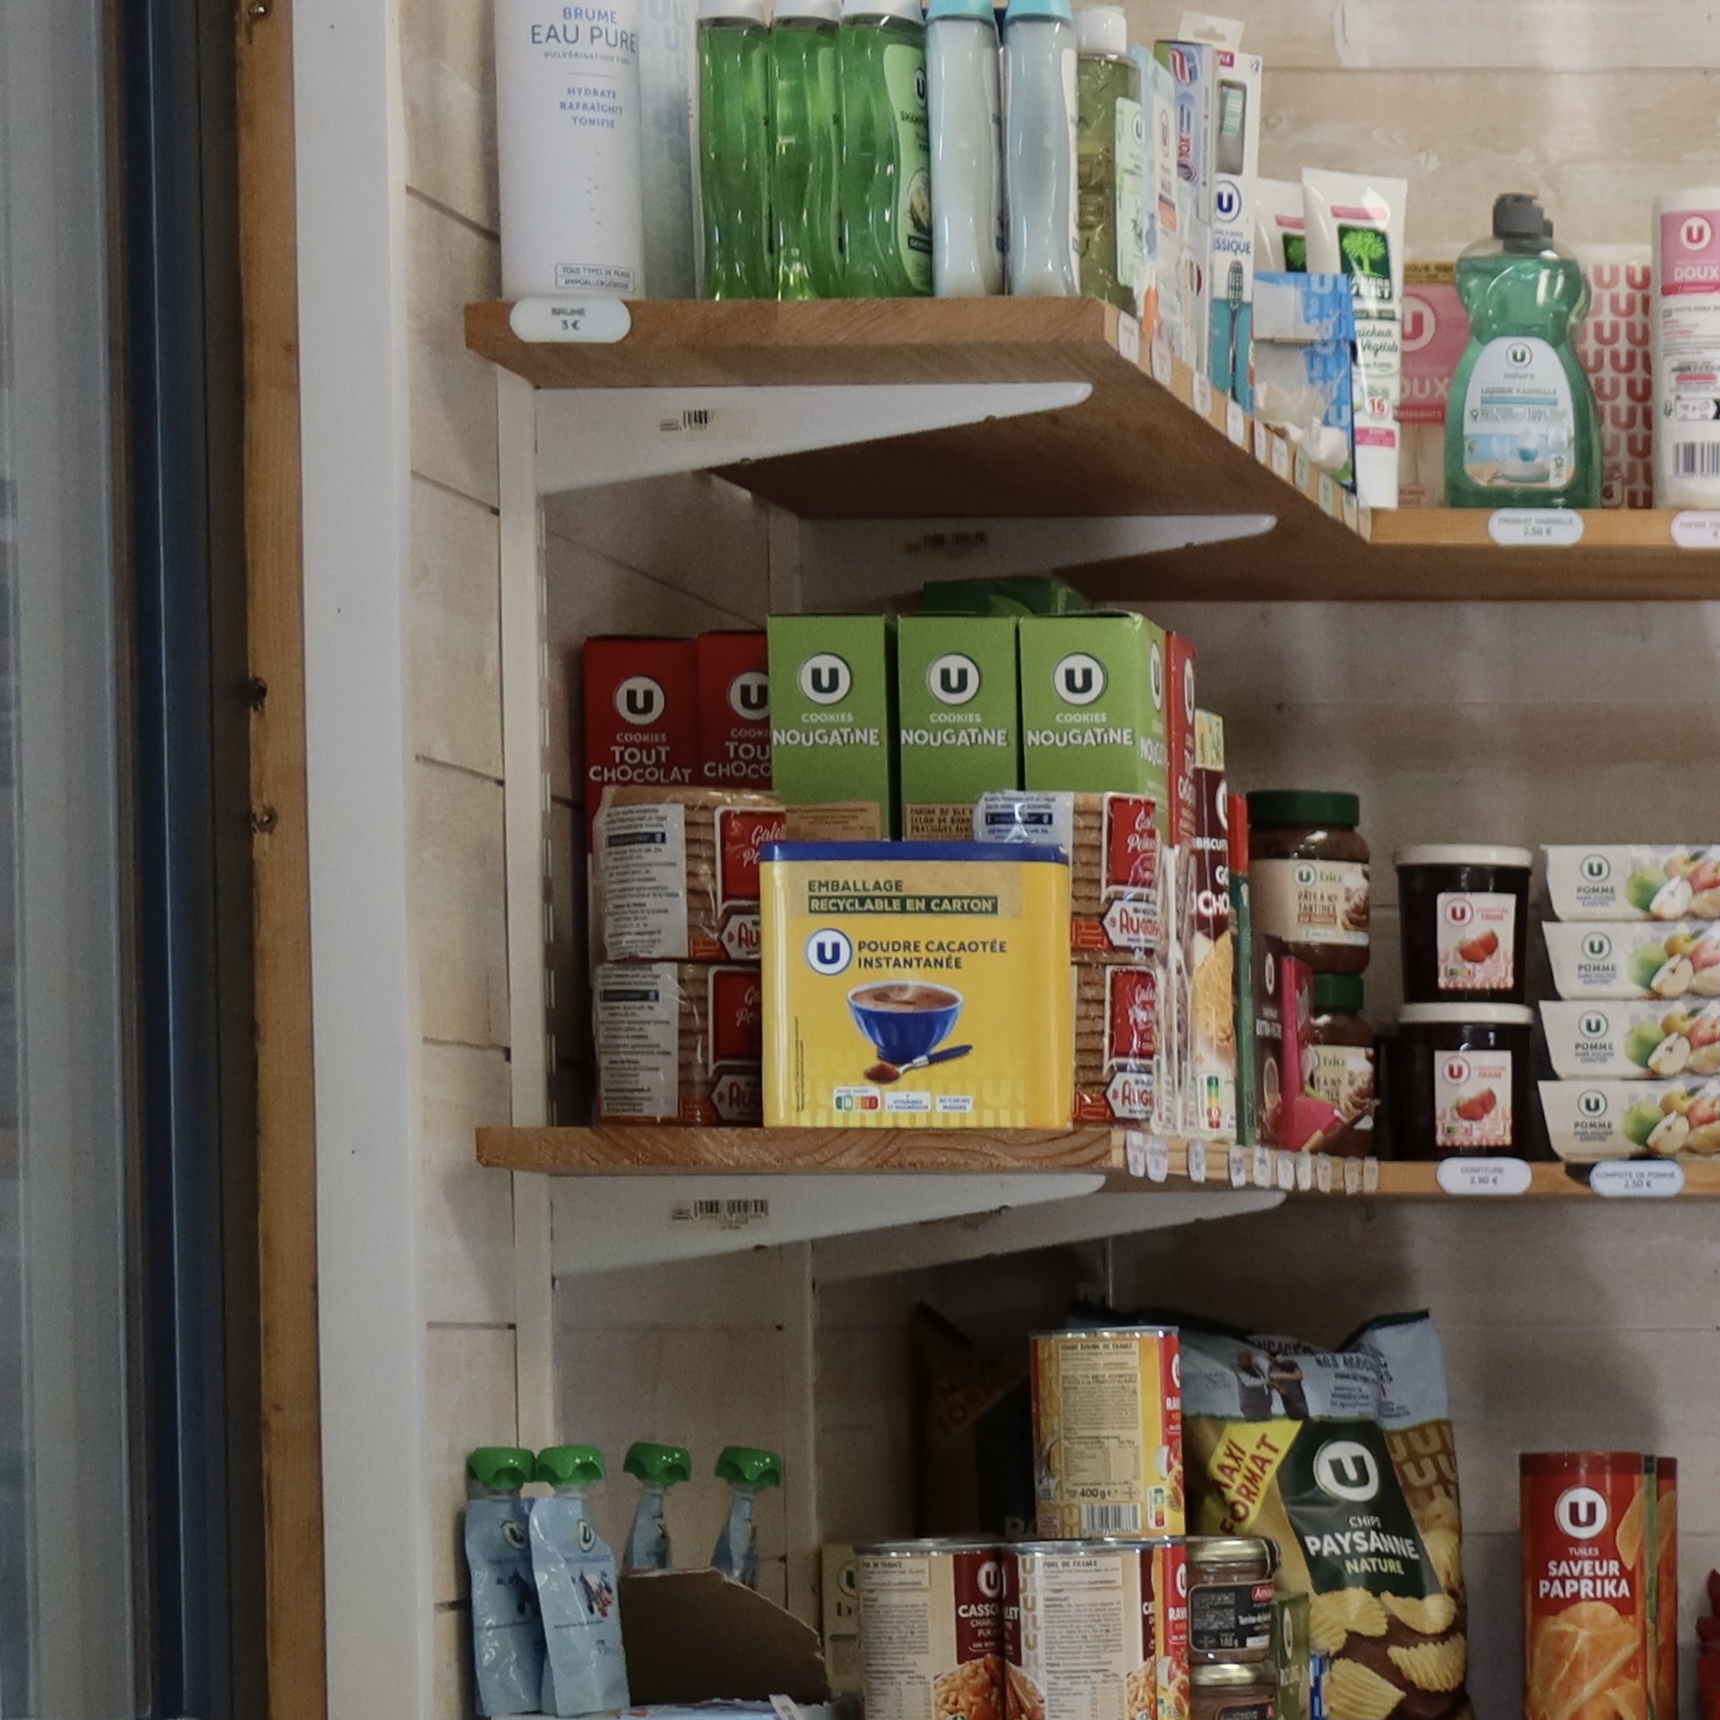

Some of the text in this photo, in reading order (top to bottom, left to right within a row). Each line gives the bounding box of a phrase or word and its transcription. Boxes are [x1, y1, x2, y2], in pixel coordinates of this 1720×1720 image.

[562, 6, 617, 24] BRUME
[531, 24, 637, 53] EAU PURE
[567, 86, 617, 100] HYDRATE
[559, 100, 623, 115] RAFRAÎCHIT
[571, 116, 616, 129] TONIFIE
[1674, 265, 1720, 281] DOUX
[551, 307, 587, 317] BRUME
[1369, 399, 1386, 414] 16
[811, 667, 840, 694] U
[940, 667, 969, 694] U
[1065, 667, 1093, 693] U
[626, 689, 655, 714] U
[801, 712, 854, 723] COOKIES
[929, 712, 982, 723] COOKIES
[1056, 711, 1107, 723] COOKIES
[616, 732, 667, 744] COOKIES
[610, 745, 670, 765] TOUT
[589, 764, 693, 783] CHOCOLAT
[1320, 869, 1343, 882] bio
[808, 880, 904, 892] EMBALLAGE
[1577, 886, 1615, 895] POMME
[811, 899, 901, 912] RECYCLABLE
[907, 899, 926, 912] EN
[816, 938, 1007, 965] U POUDRE CACAOTÉE
[858, 956, 963, 970] INSTANTANÉE
[1578, 963, 1616, 973] POMME
[1575, 1042, 1614, 1051] POMME
[1574, 1121, 1613, 1130] POMME
[1327, 1454, 1370, 1490] U
[1219, 1433, 1281, 1536] FORMAT
[1079, 1487, 1099, 1499] 400
[1568, 1502, 1597, 1526] U
[1304, 1530, 1421, 1562] PAYSANNE
[1568, 1547, 1600, 1556] TUILES
[1548, 1560, 1620, 1577] SAVEUR
[1538, 1578, 1630, 1599] PAPRIKA
